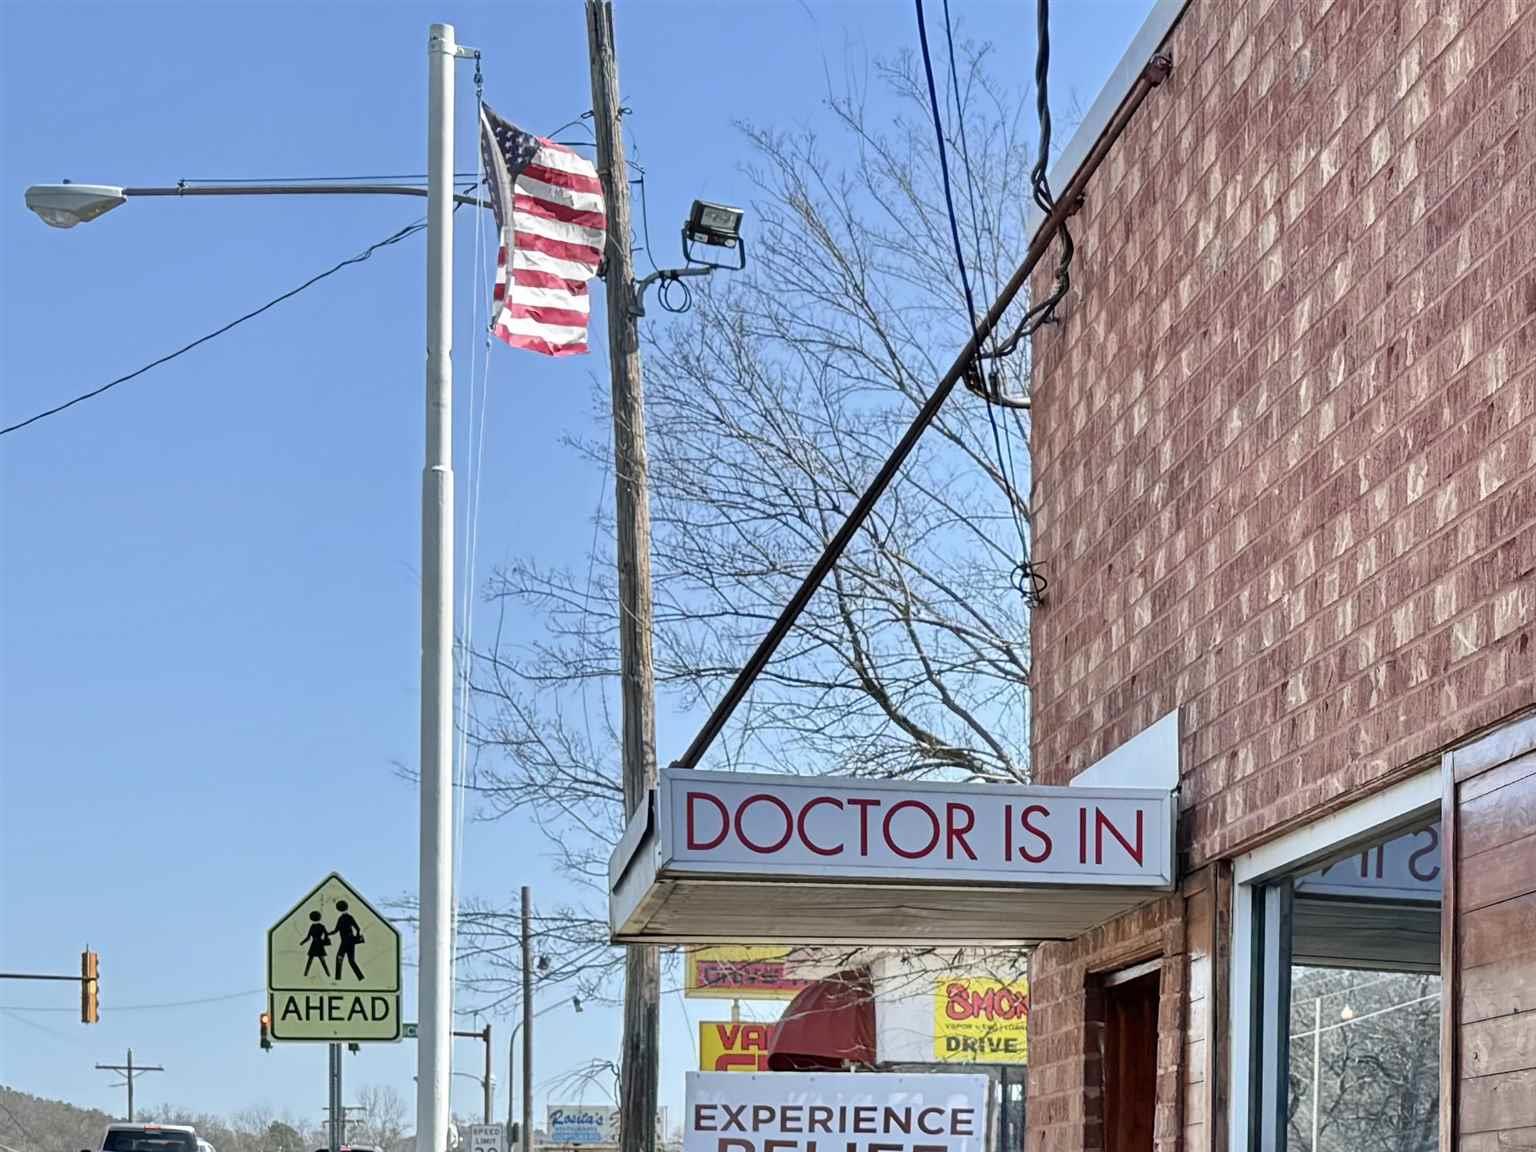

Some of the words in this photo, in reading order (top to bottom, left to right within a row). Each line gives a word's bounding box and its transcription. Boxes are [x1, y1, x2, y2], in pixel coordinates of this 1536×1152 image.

[687, 792, 978, 860] DOCTOR
[1005, 804, 1053, 864] IS
[1080, 806, 1144, 868] IN
[281, 996, 390, 1021] AHEAD
[946, 983, 1029, 1021] SMOK
[716, 1024, 777, 1051] VA
[946, 1036, 1018, 1053] DRIVE
[472, 1128, 500, 1136] SPEED
[694, 1103, 976, 1136] EXPERIENCE
